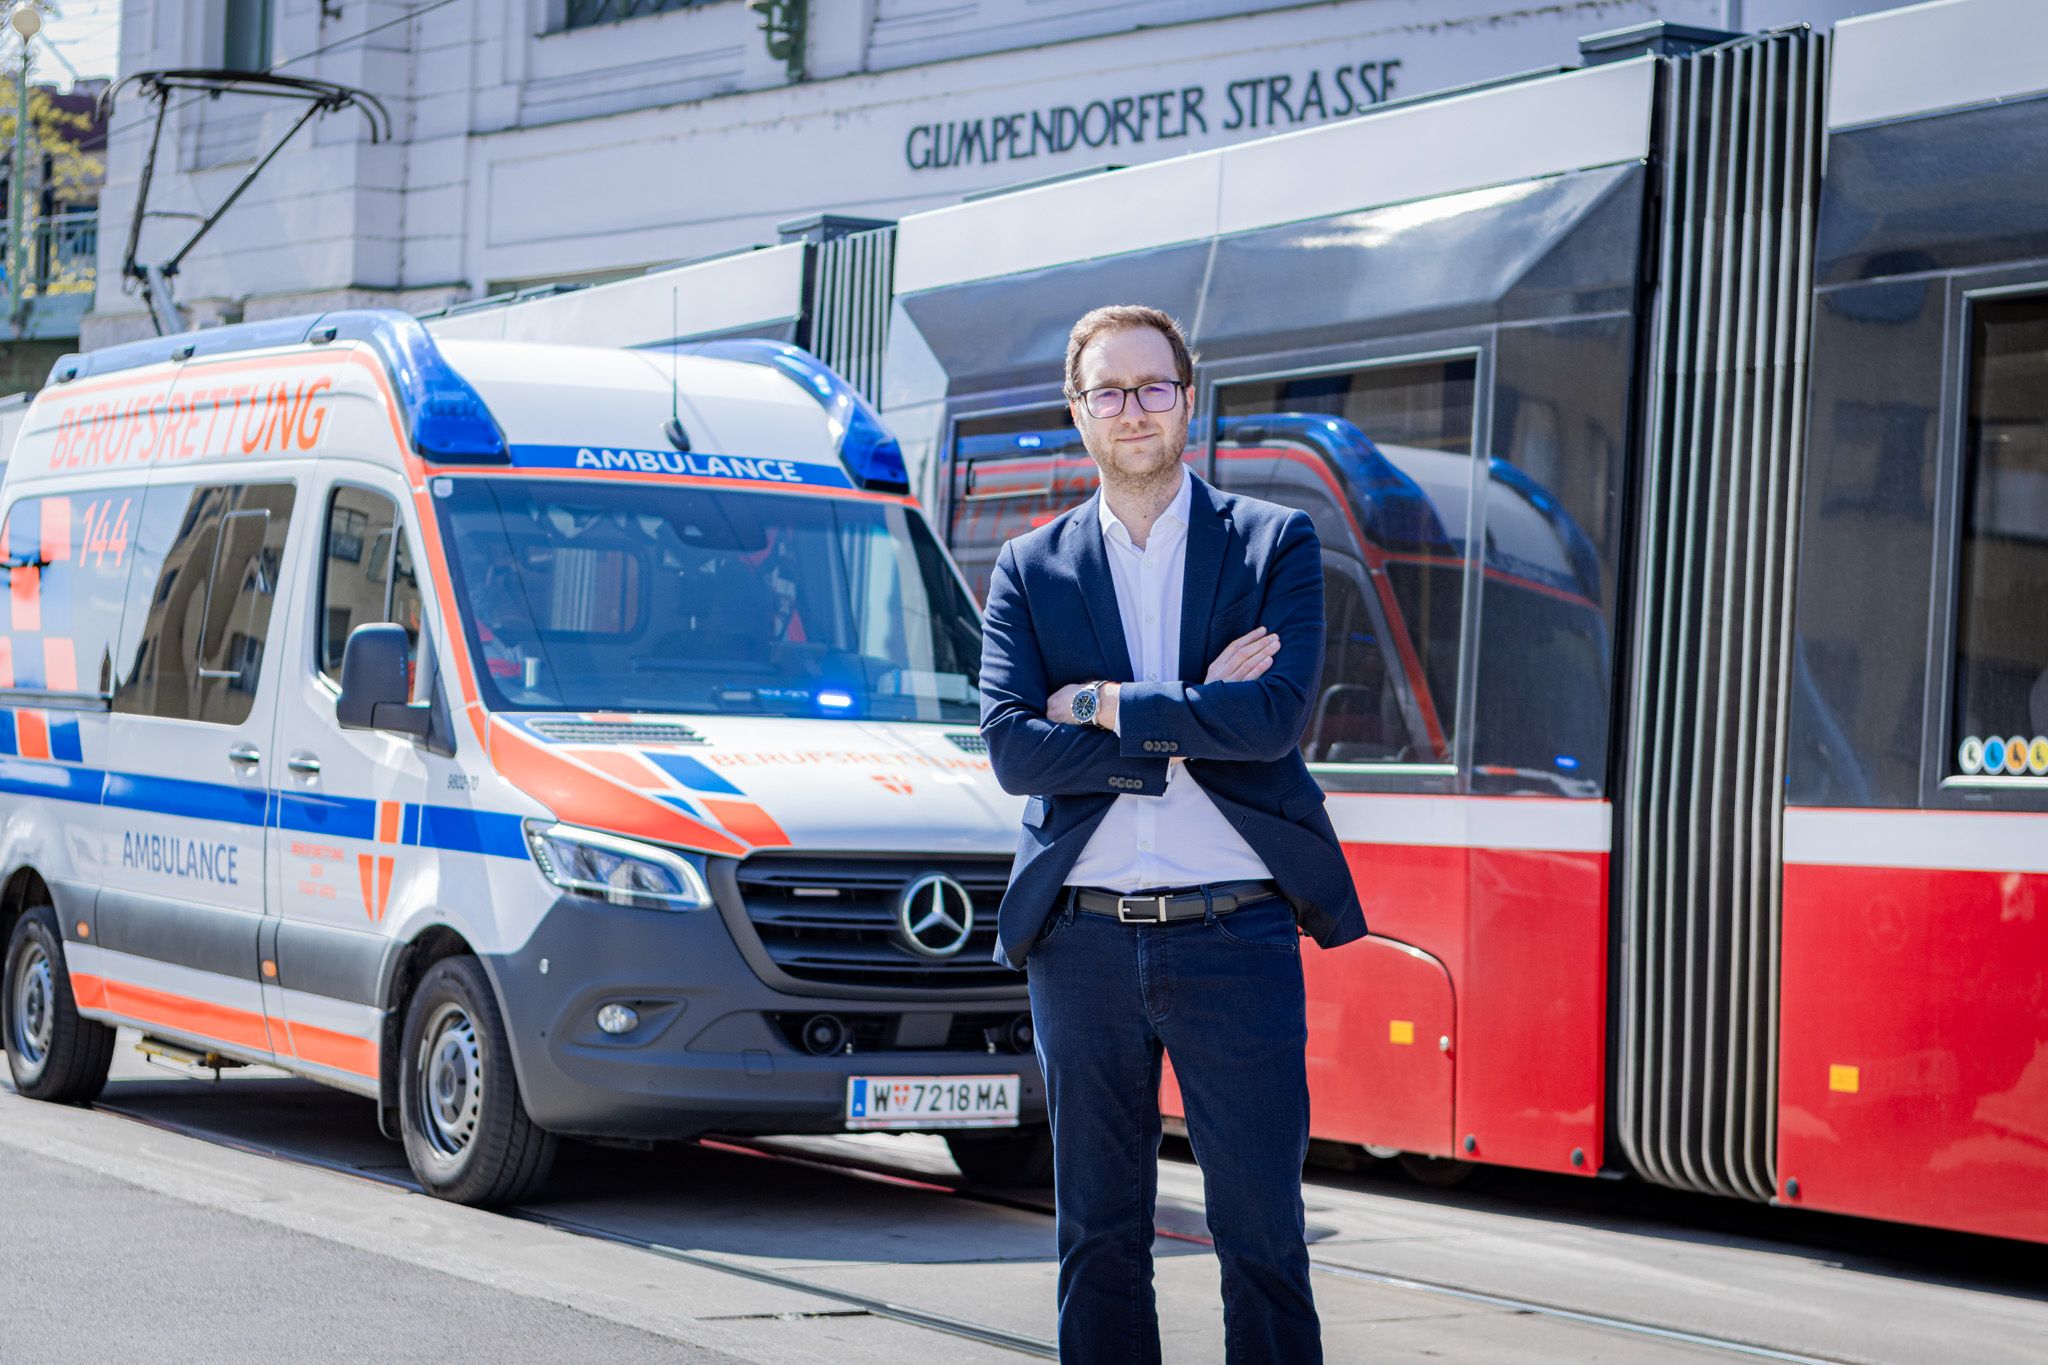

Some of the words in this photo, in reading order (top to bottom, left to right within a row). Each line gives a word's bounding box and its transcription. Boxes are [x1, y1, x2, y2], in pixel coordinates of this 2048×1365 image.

[905, 85, 1208, 170] GUMPENDORFER
[48, 376, 332, 472] BERUFSRETTUNG
[575, 447, 803, 483] AMBULANCE
[78, 497, 132, 569] 144
[122, 830, 239, 886] AMBULANCE
[872, 1084, 892, 1112] W
